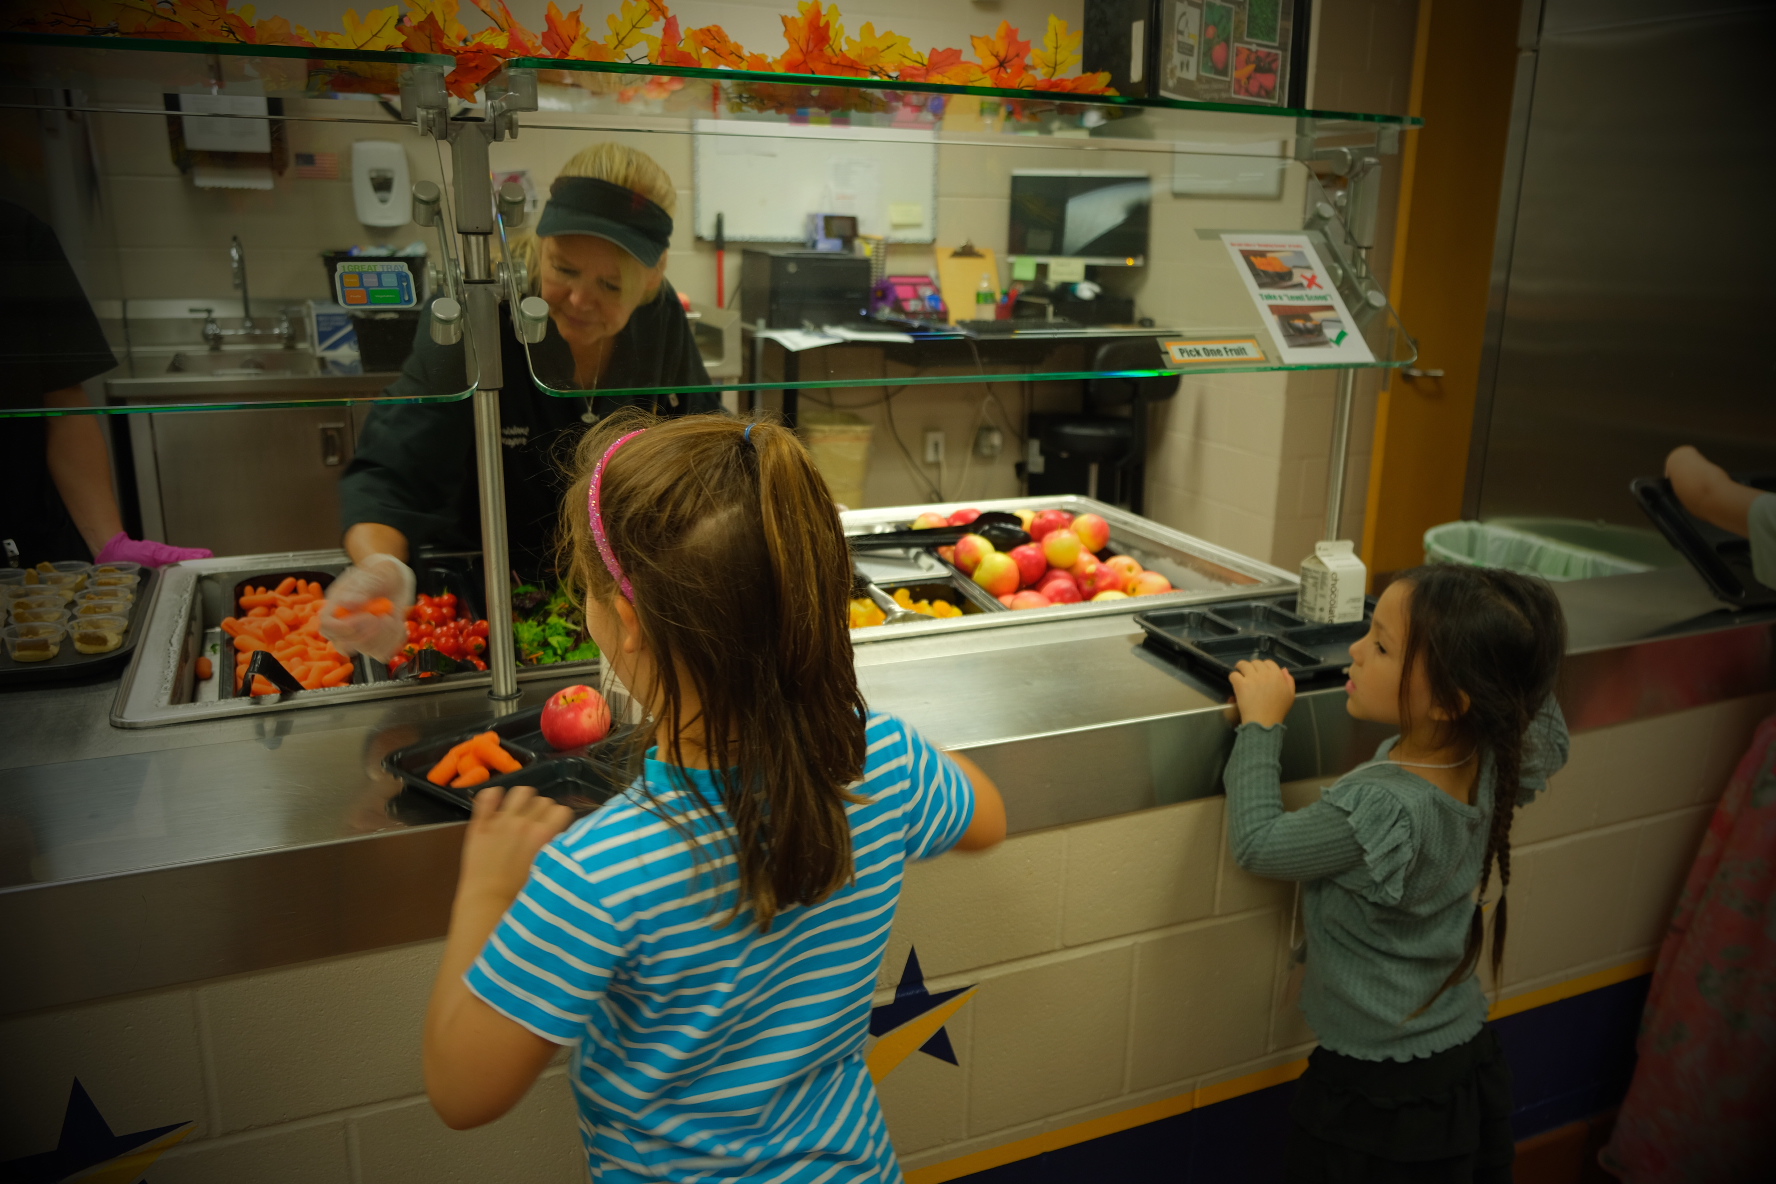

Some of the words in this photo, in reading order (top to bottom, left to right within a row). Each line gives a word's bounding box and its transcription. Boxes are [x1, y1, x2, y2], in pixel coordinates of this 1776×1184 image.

[379, 264, 404, 272] TRAY
[1259, 293, 1278, 301] Take
[1178, 347, 1202, 358] Pick
[1202, 347, 1224, 358] One
[1223, 346, 1248, 357] Fruit
[1328, 572, 1339, 624] chocolate
